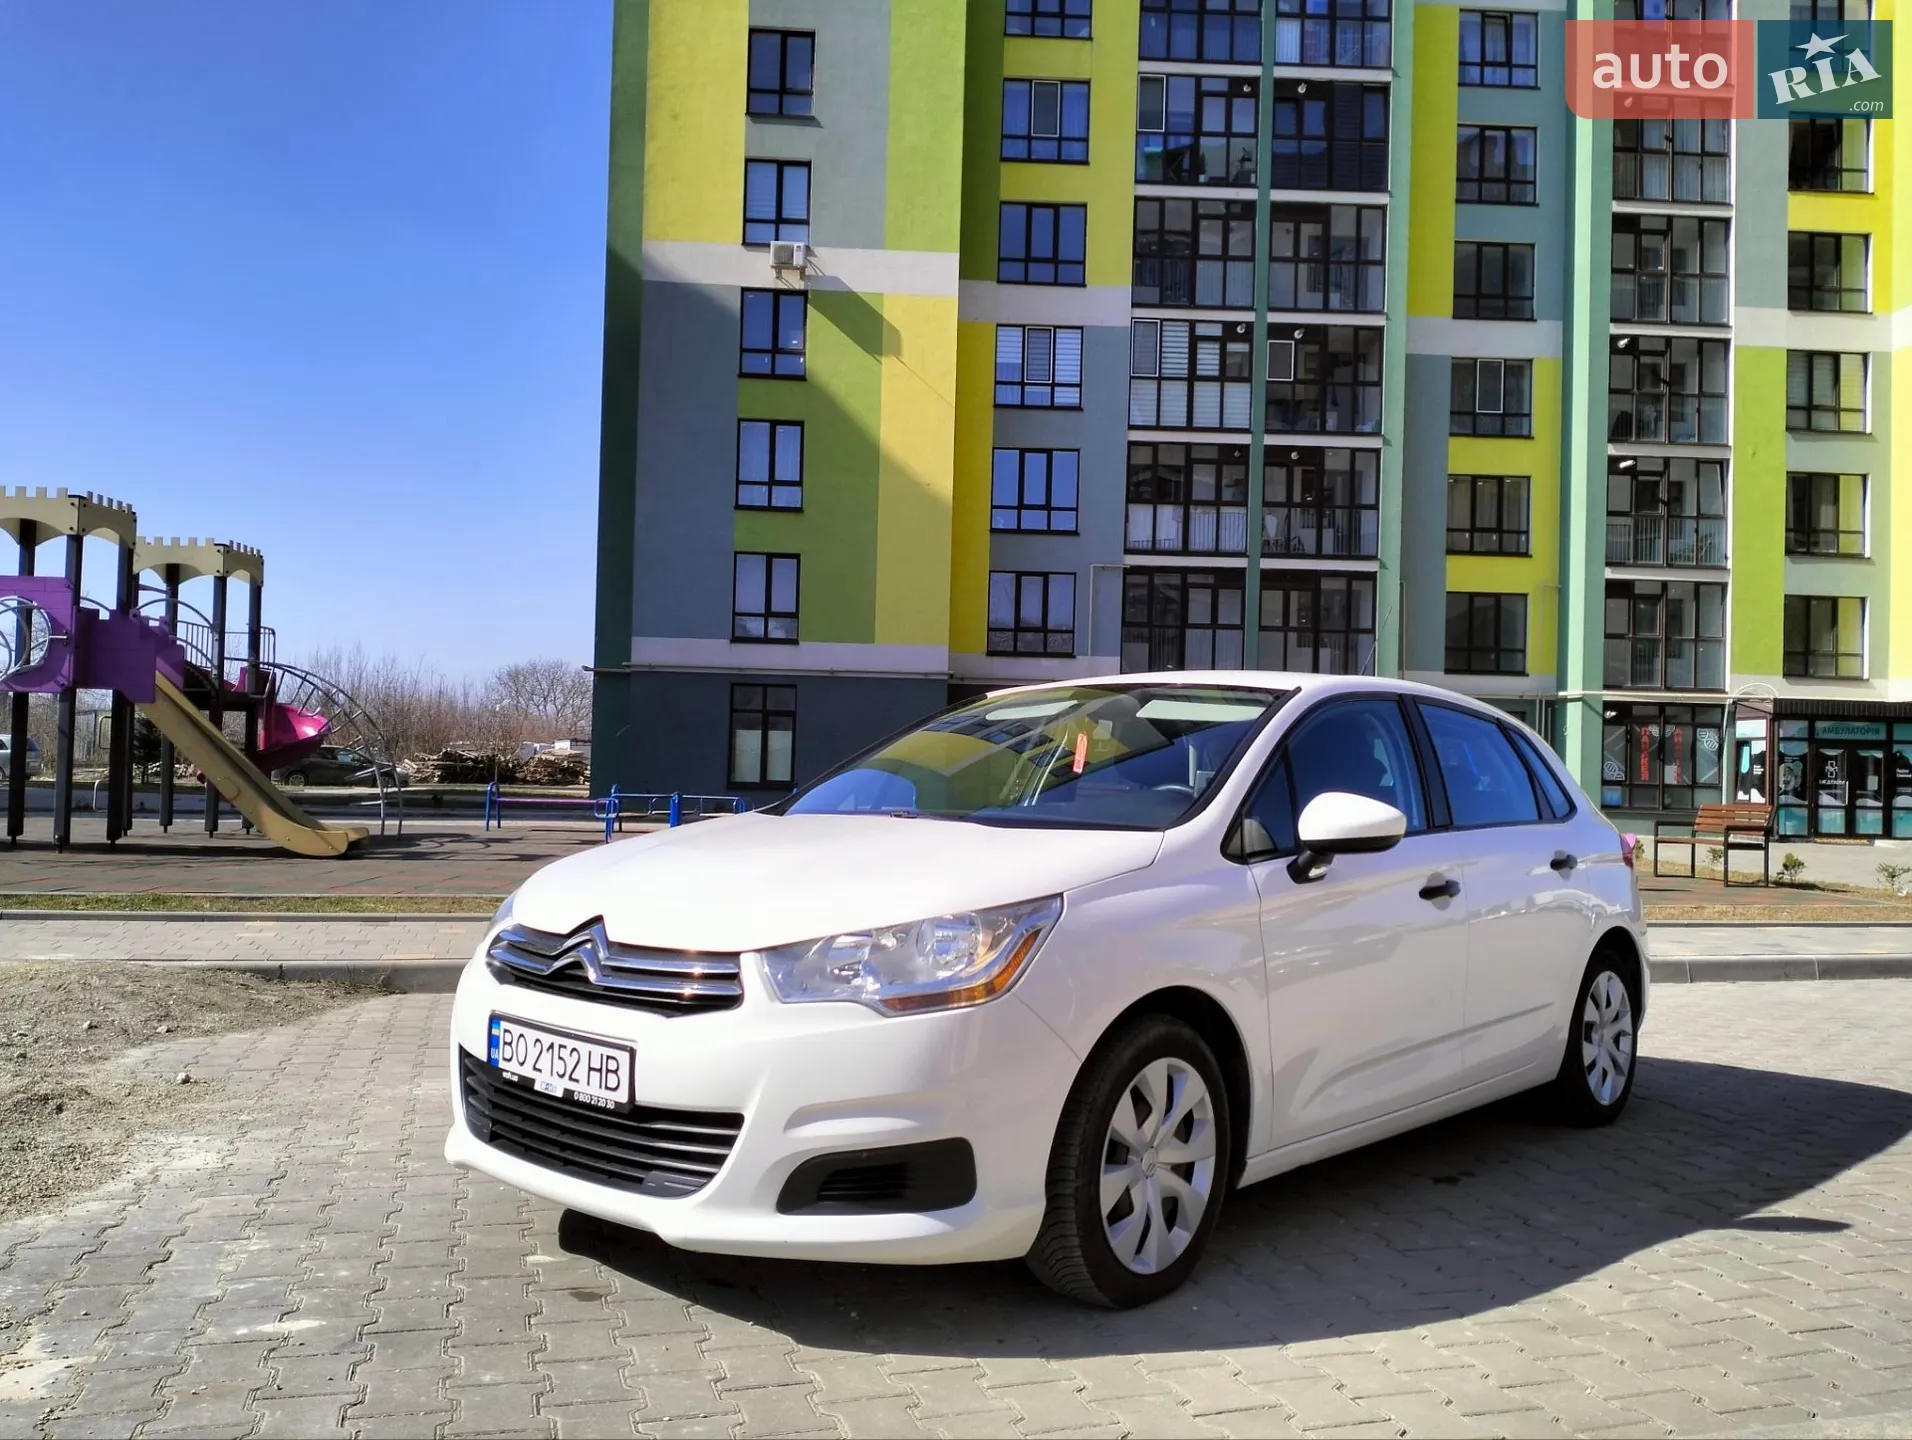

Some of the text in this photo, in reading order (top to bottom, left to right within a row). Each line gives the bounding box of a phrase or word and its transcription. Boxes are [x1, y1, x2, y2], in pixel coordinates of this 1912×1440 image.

[1822, 726, 1880, 736] АМБУЛАТОРІЯ
[490, 1046, 499, 1060] UA
[502, 1028, 621, 1092] BO 2152 HB
